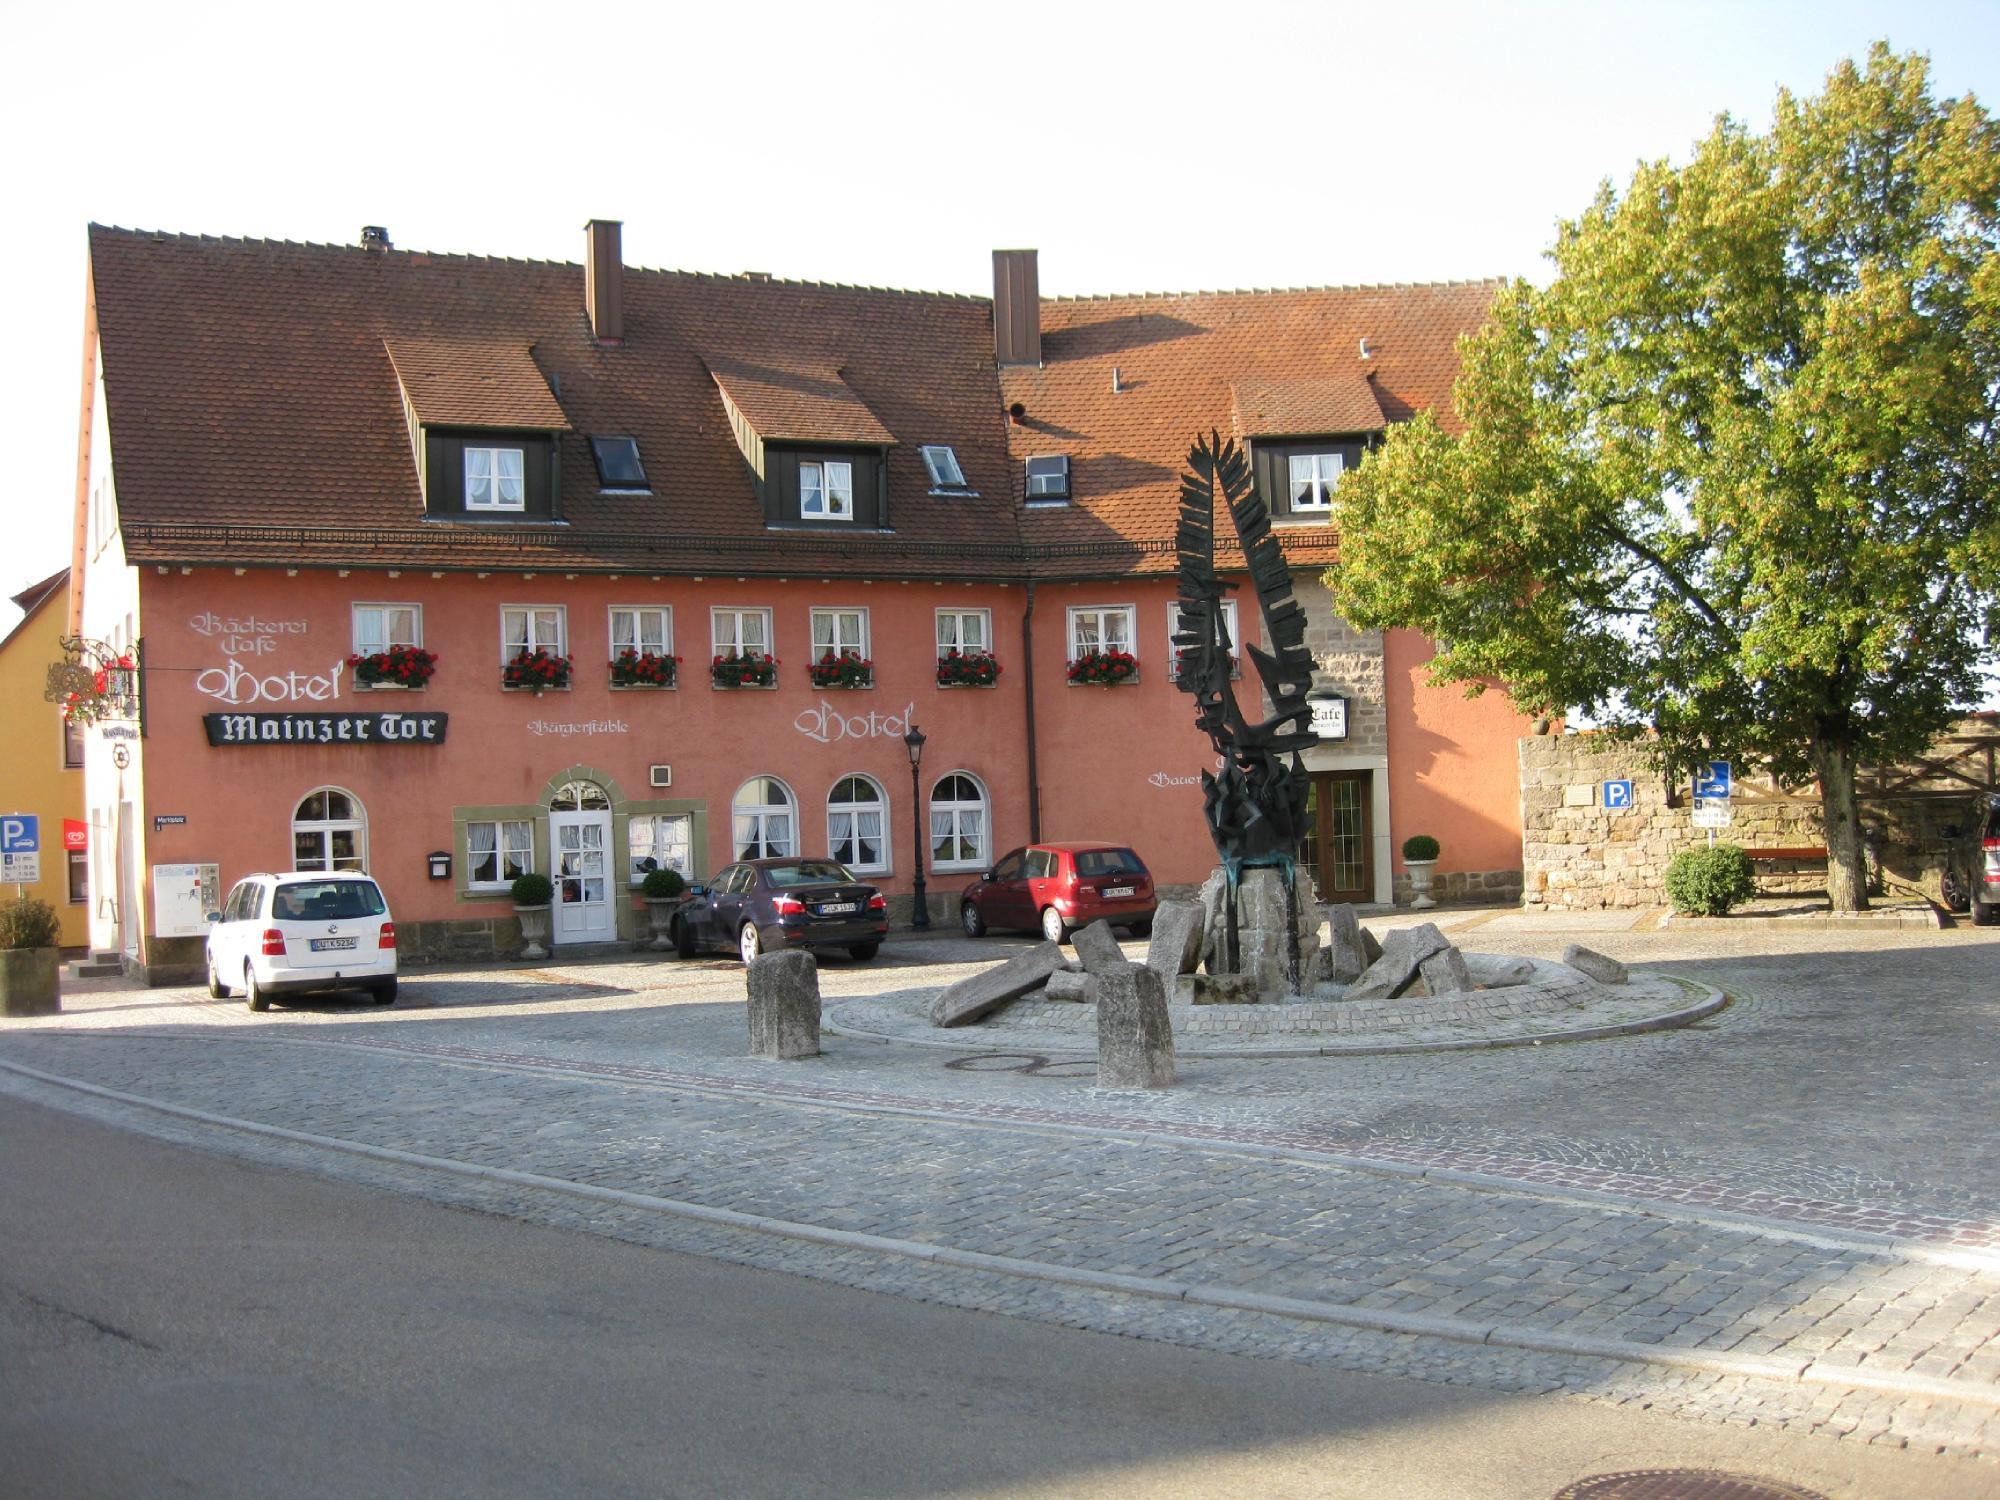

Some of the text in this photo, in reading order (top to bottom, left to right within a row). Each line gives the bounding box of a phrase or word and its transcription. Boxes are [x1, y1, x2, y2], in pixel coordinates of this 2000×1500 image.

[190, 611, 308, 636] Bäckerei
[221, 634, 277, 656] Cafe
[197, 658, 344, 704] Hotel
[794, 697, 914, 743] Hotel
[1311, 707, 1341, 721] Cafe
[220, 713, 436, 743] Mainzer Tor
[1147, 771, 1202, 788] Bauer
[1697, 766, 1715, 793] P
[1609, 784, 1624, 805] P
[3, 820, 25, 849] P
